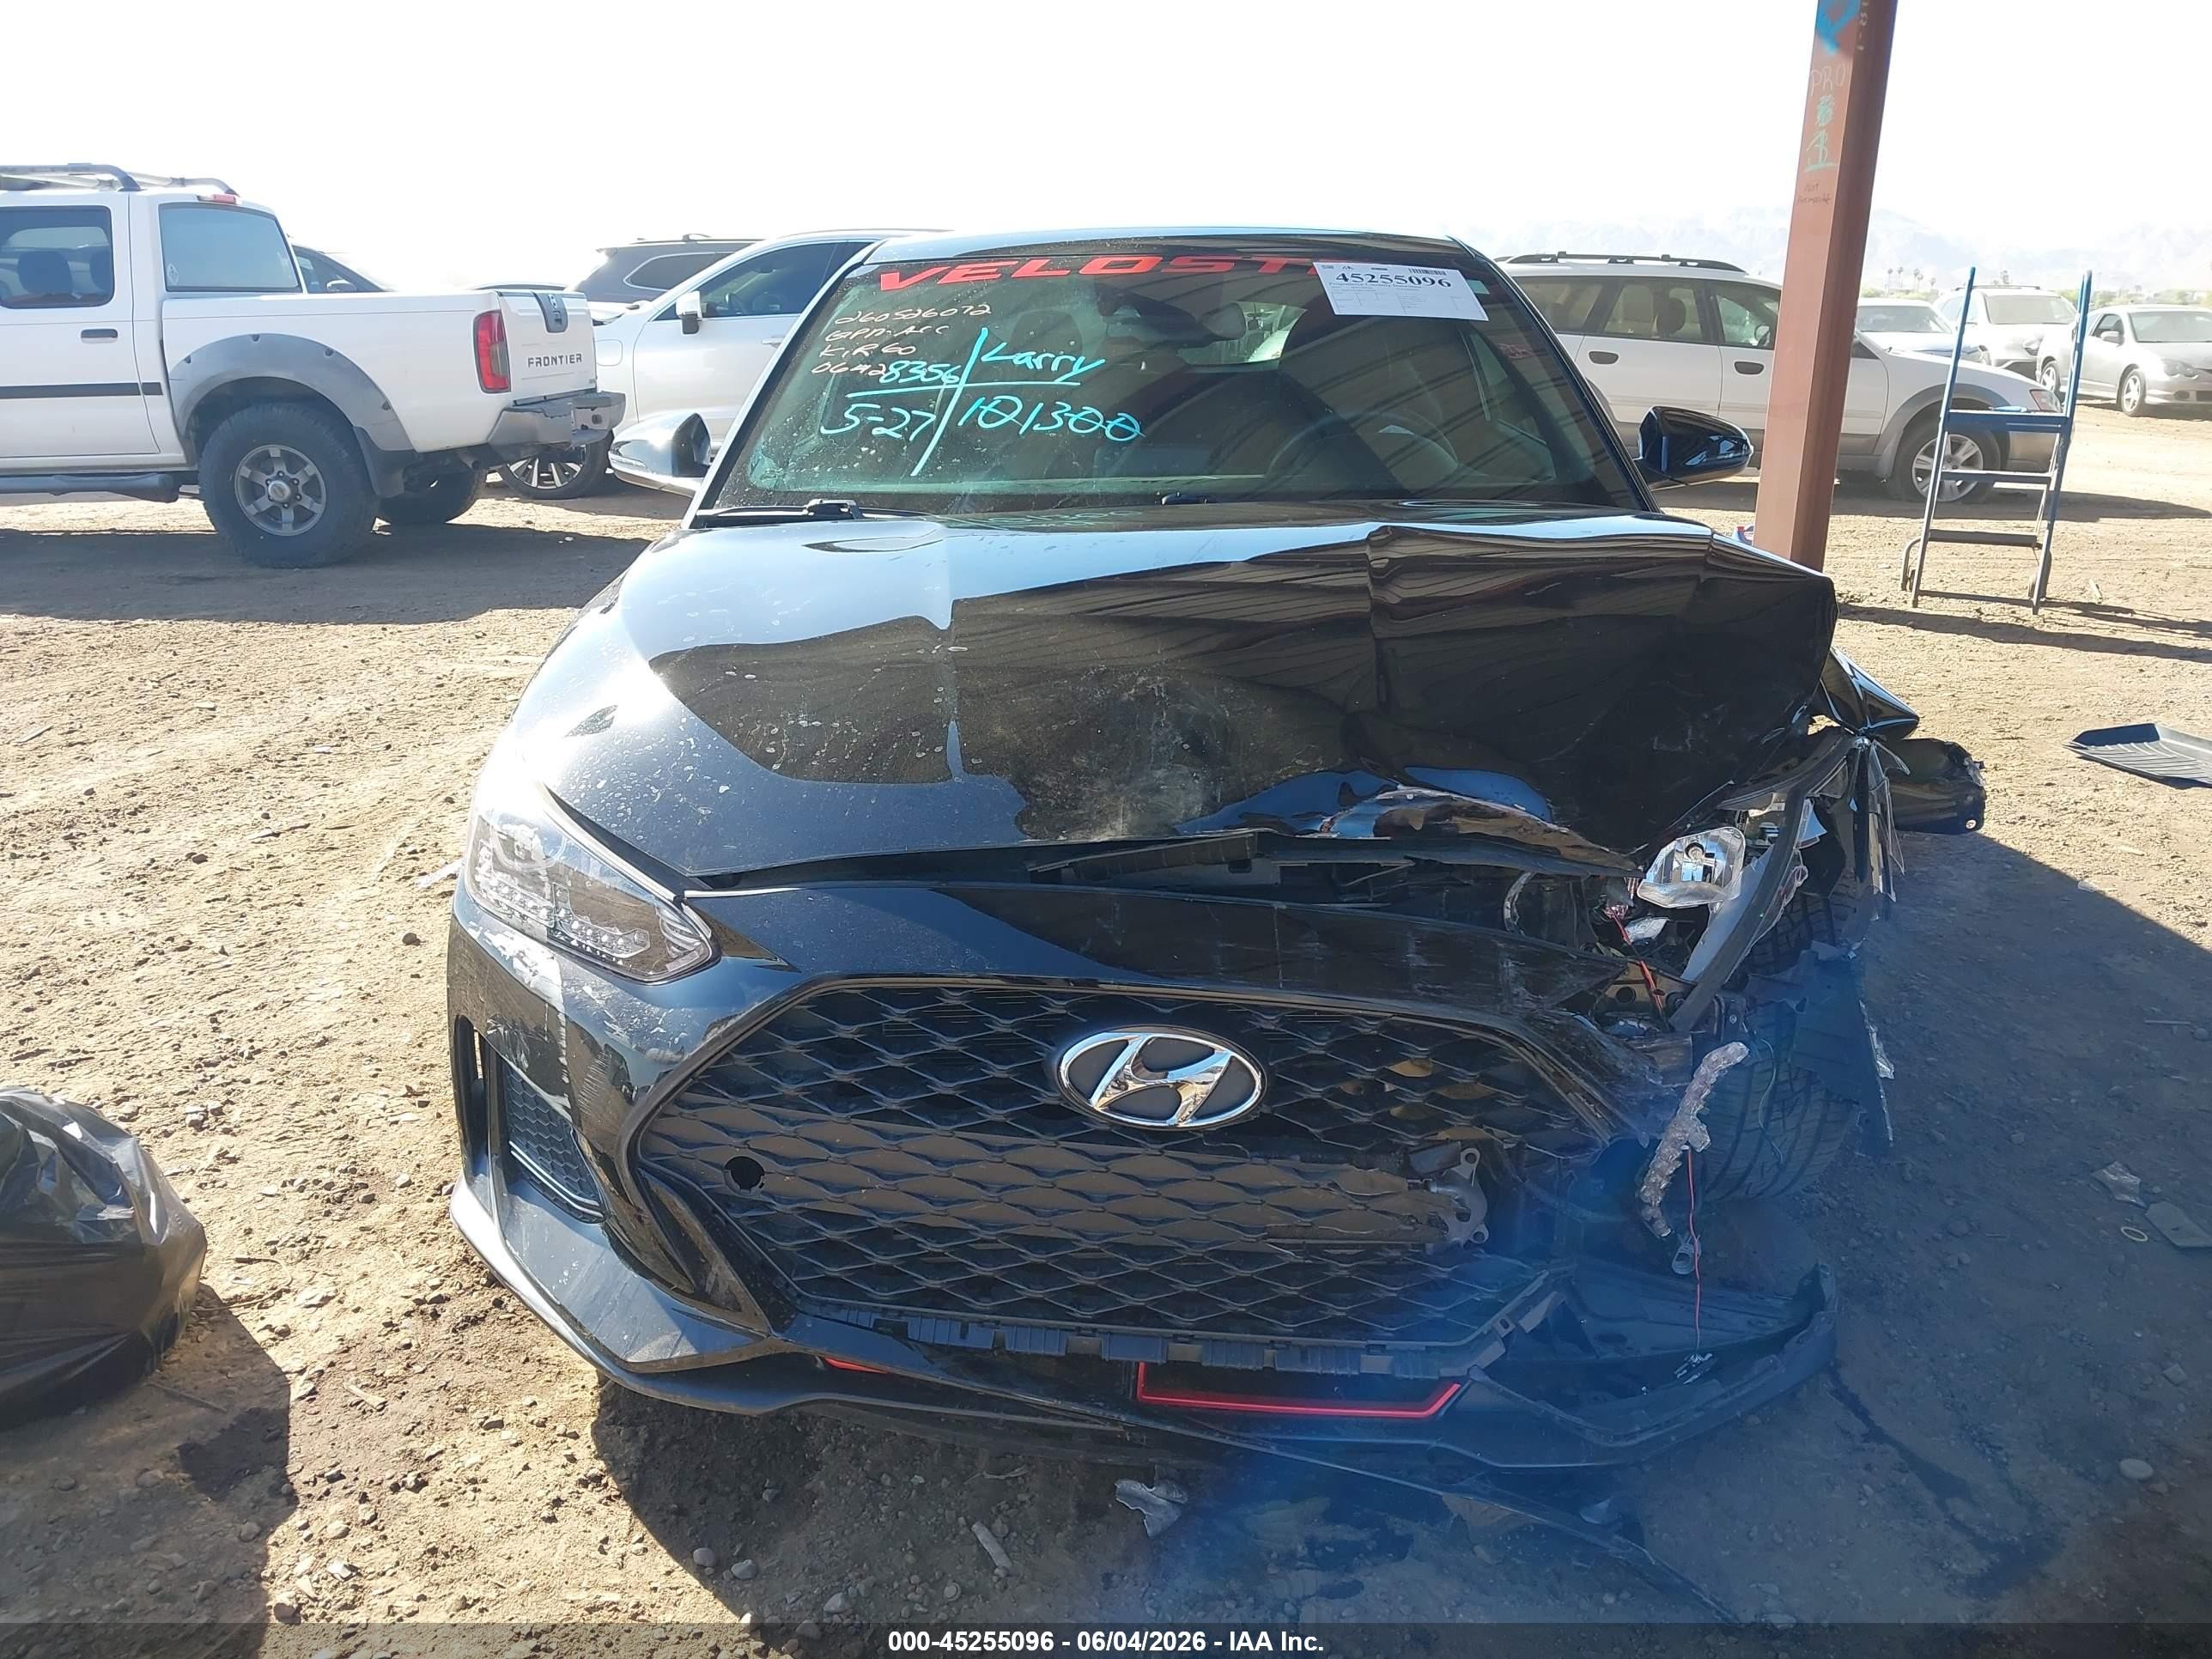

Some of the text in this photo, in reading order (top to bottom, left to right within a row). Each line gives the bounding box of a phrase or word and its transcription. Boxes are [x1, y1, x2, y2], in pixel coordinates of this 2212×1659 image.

[879, 255, 1318, 291] VELOST
[1335, 271, 1451, 289] 45255096
[527, 353, 583, 368] FRONTIER
[981, 342, 1106, 383] Larry
[820, 403, 937, 441] 5-27
